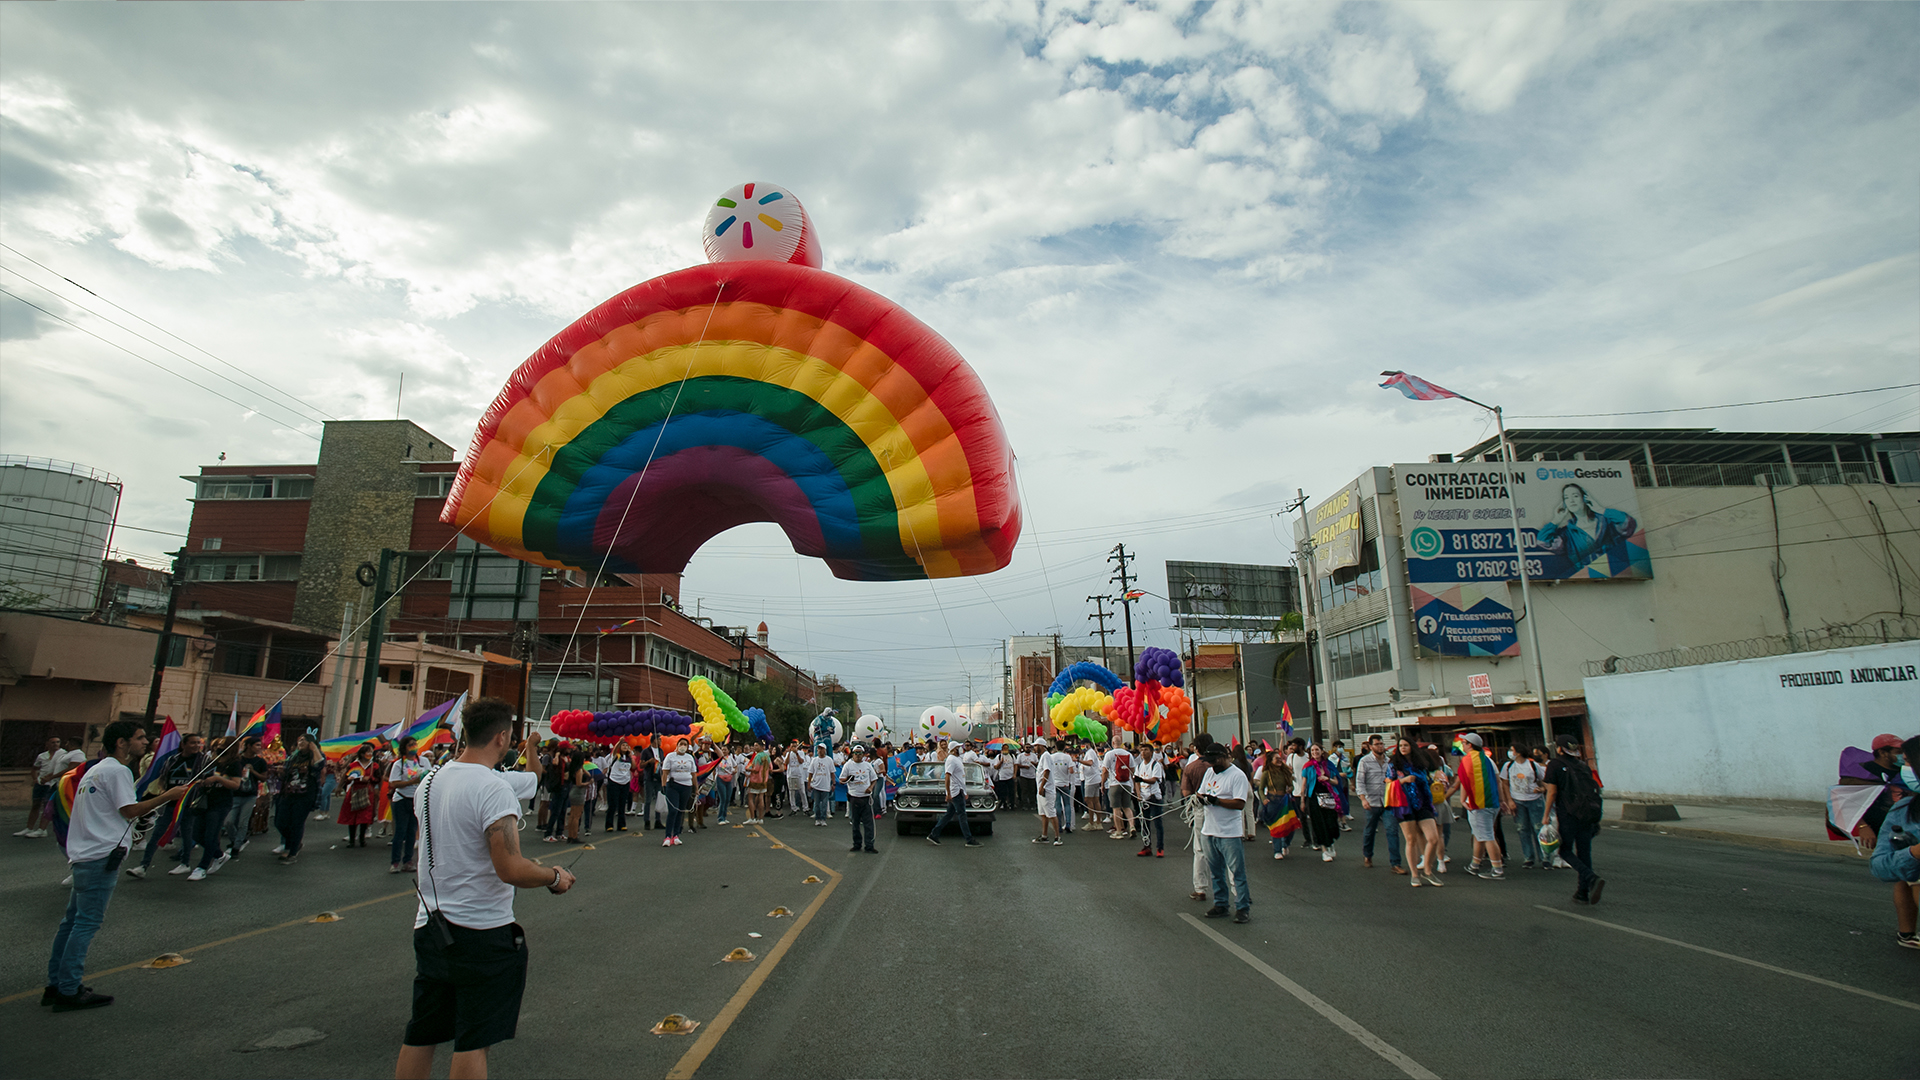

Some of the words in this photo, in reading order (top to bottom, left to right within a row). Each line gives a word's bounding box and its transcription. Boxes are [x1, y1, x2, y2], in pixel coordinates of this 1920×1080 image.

[1549, 468, 1622, 479] TeleGestión
[1425, 486, 1510, 500] INMEDIATA
[1452, 533, 1469, 550] 81
[1471, 532, 1504, 550] 8372
[1506, 531, 1537, 549] 100
[1456, 561, 1473, 578] 81
[1475, 560, 1509, 578] 2602
[1510, 559, 1543, 577] 983
[1779, 670, 1844, 688] PROHIBIDO
[1850, 665, 1918, 683] ANUNCIAR
